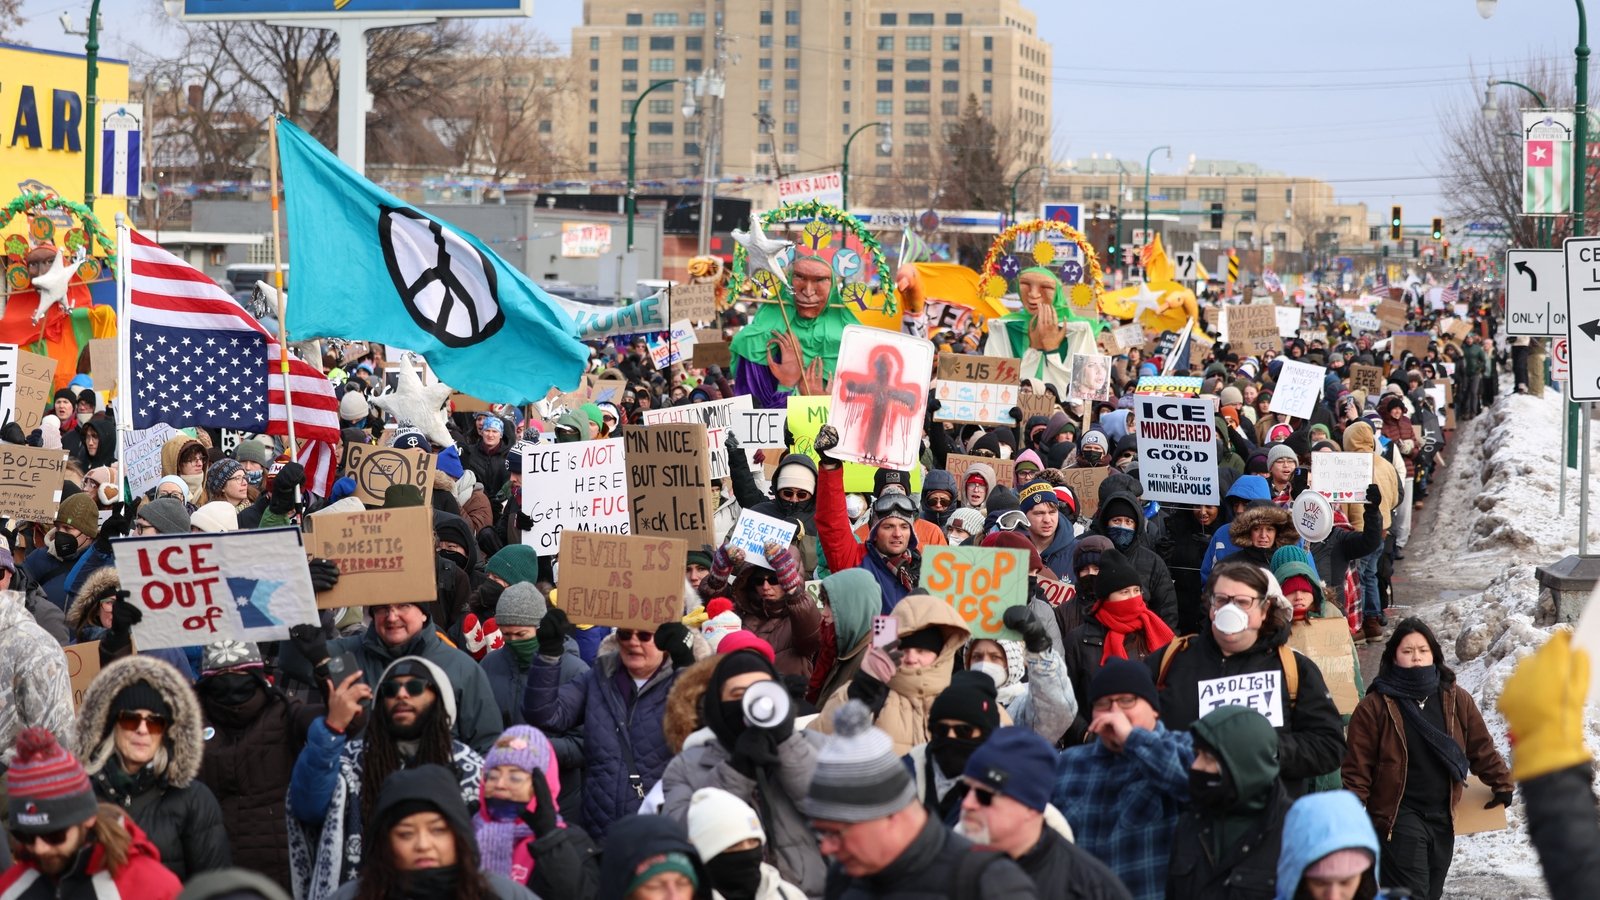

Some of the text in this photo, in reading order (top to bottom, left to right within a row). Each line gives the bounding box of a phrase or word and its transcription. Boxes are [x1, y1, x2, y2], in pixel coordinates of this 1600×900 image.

[0, 82, 82, 152] AR
[780, 175, 839, 196] ERIK'S AUTO
[1579, 247, 1600, 262] CE
[1512, 312, 1544, 324] ONLY
[1553, 314, 1566, 324] ON
[1254, 342, 1274, 350] ICE
[17, 362, 51, 381] GA
[965, 363, 989, 380] 1/5
[1357, 369, 1378, 378] FUCK
[1355, 377, 1375, 388] ICE
[1143, 402, 1207, 422] ICE
[743, 412, 779, 443] ICE
[1140, 421, 1211, 442] MURDERED
[224, 437, 235, 447] IS
[626, 431, 649, 453] MN
[656, 431, 697, 456] NICE,
[1424, 428, 1436, 452] OUT
[0, 452, 64, 472] BOLISH
[528, 451, 560, 473] ICE
[568, 453, 577, 470] is
[581, 445, 615, 468] NOT
[1147, 448, 1209, 462] GOOD
[2, 469, 41, 482] ICE
[632, 465, 705, 488] BUT STILL
[947, 457, 1012, 481] PROUTE
[1062, 469, 1094, 486] CE
[575, 472, 624, 493] HERE
[1148, 480, 1212, 496] MINNEAPOLIS
[531, 495, 629, 523] Get the FUC
[1304, 501, 1322, 515] LOVE
[347, 512, 391, 526] TRUMP
[1301, 518, 1315, 530] ICE
[342, 525, 382, 538] IS THE
[541, 522, 629, 547] of Minne
[732, 536, 744, 547] OF
[743, 528, 766, 543] FUCK
[758, 522, 776, 535] GET
[777, 529, 792, 542] THE
[322, 537, 403, 557] DOMESTIC
[572, 536, 673, 571] EVIL IS
[137, 544, 219, 576] ICE
[332, 556, 403, 574] TERRORIST
[608, 571, 633, 589] AS
[927, 551, 1016, 595] STOP
[141, 577, 219, 610] OUT
[567, 587, 677, 624] EVIL DOES
[182, 606, 223, 633] of
[1200, 673, 1275, 699] ABOLISH
